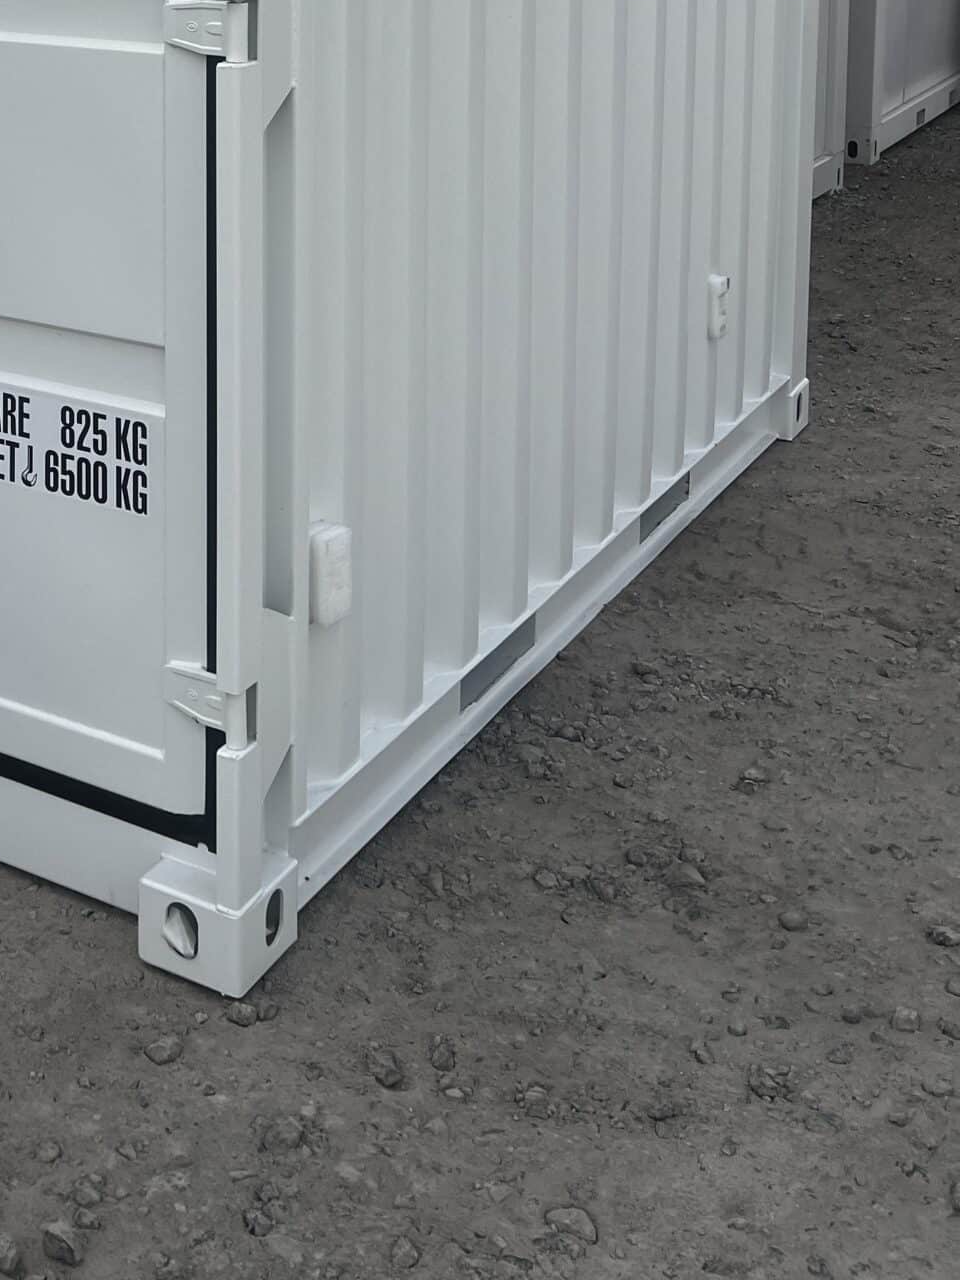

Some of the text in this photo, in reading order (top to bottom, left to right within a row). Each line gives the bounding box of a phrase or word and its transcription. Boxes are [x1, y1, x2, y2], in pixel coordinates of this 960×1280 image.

[60, 405, 107, 456] 825
[115, 417, 148, 466] KG
[44, 449, 108, 505] 6500
[115, 465, 148, 516] KG
